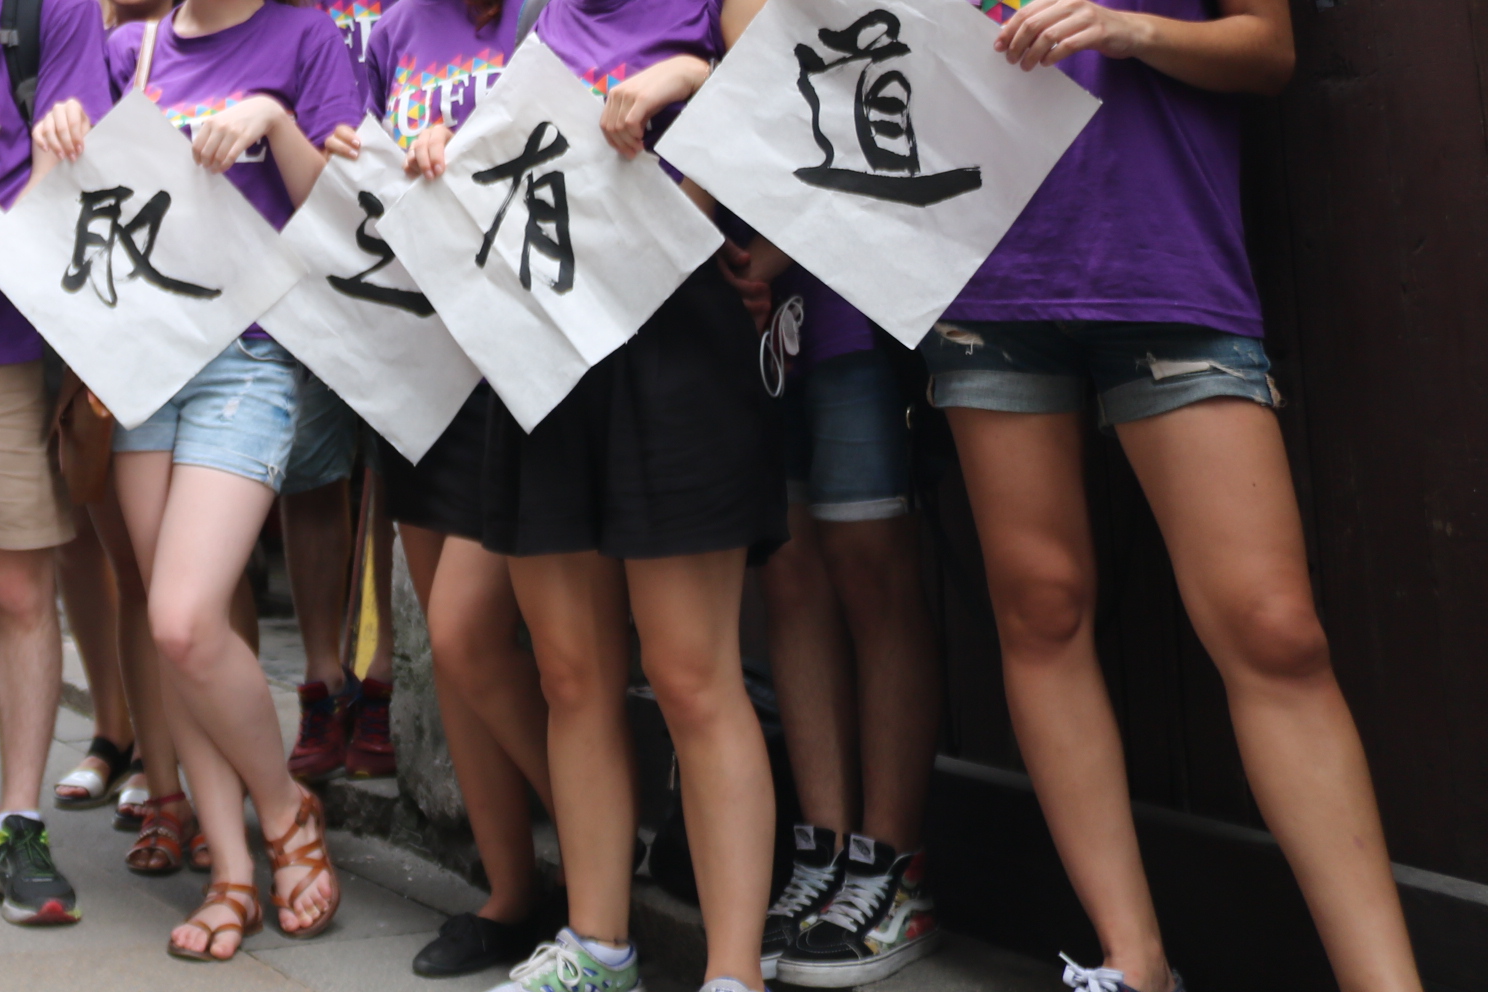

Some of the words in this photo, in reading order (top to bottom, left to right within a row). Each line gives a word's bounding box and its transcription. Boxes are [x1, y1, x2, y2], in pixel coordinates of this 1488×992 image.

[793, 9, 982, 208] 道
[61, 185, 222, 307] 取
[326, 190, 437, 317] 之
[471, 121, 576, 295] 有
